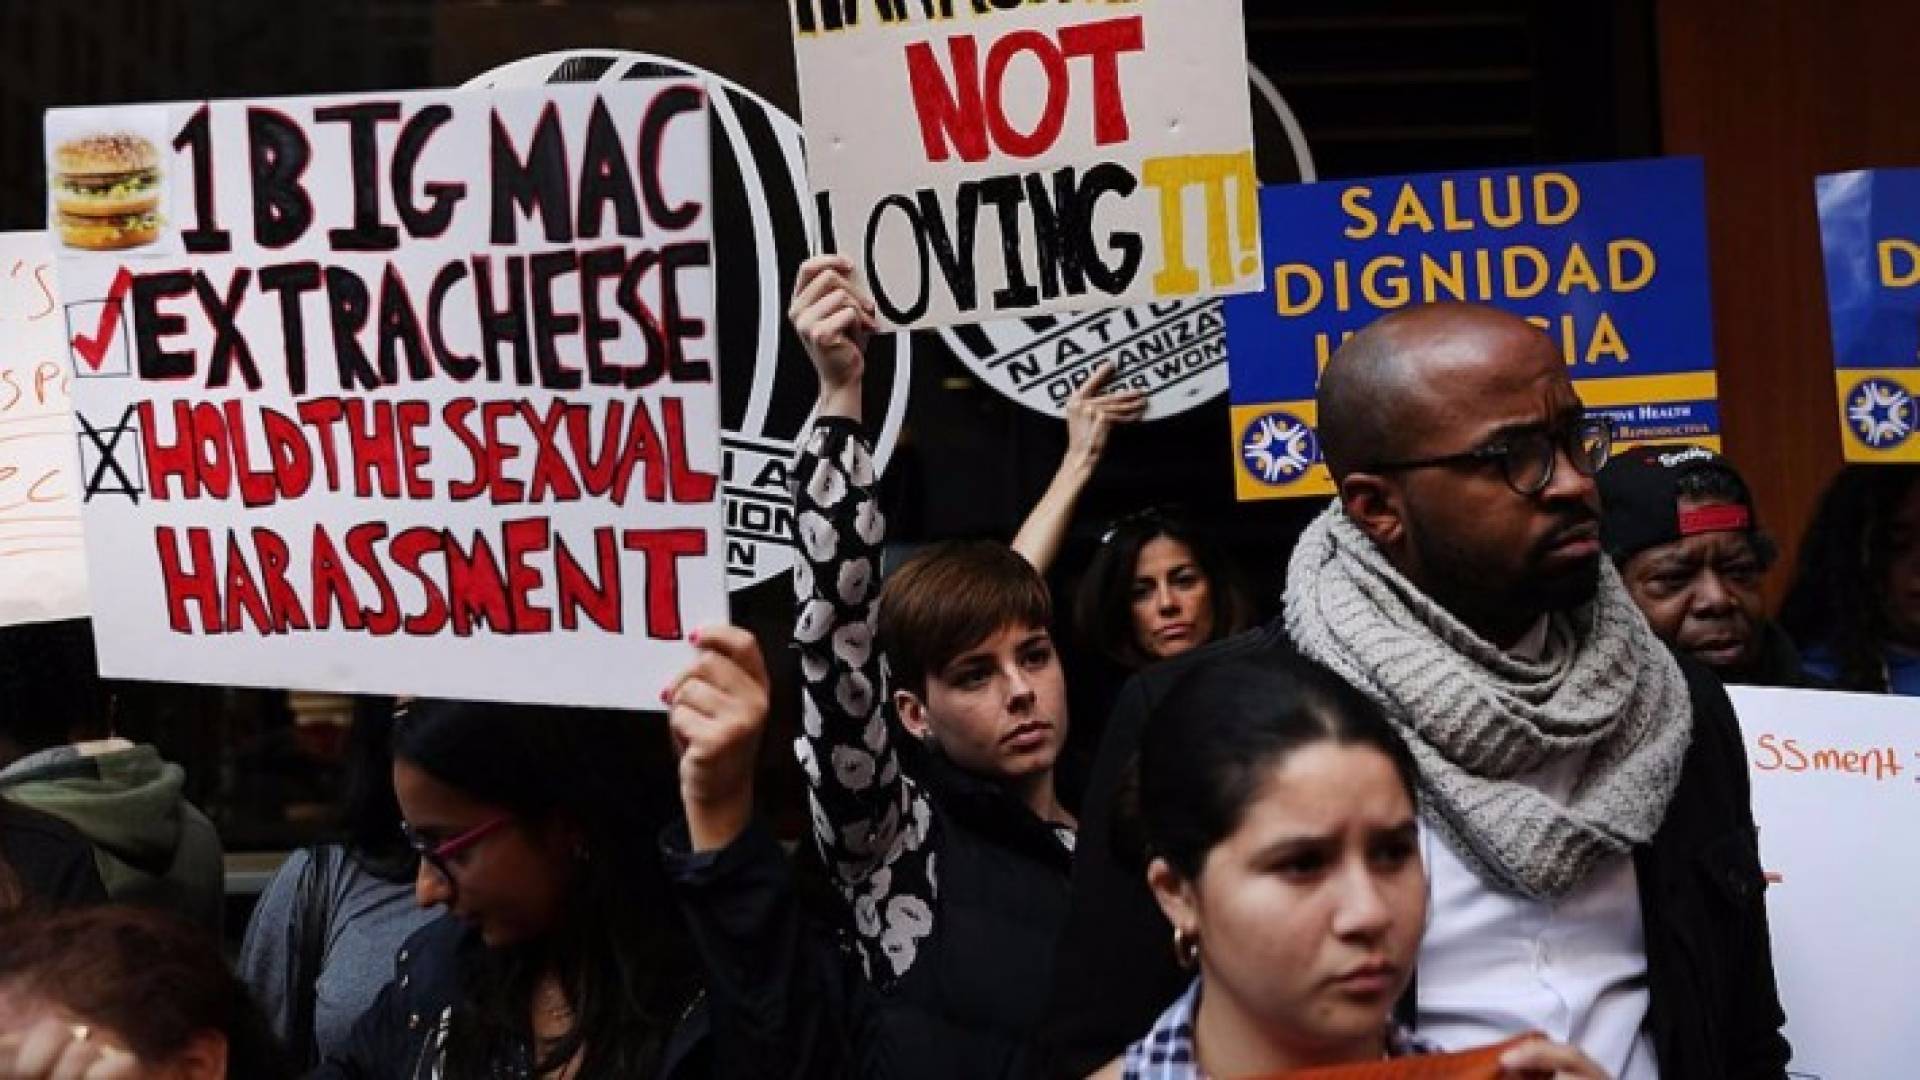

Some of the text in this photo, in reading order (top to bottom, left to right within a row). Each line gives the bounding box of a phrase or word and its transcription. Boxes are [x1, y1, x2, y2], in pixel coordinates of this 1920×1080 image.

[905, 16, 1144, 162] NOT
[172, 84, 707, 253] 1 BIG MAC
[1142, 151, 1256, 295] IT!
[1340, 172, 1582, 239] SALUD
[1274, 238, 1656, 317] DIGNIDAD
[155, 517, 707, 640] HARASSMENT
